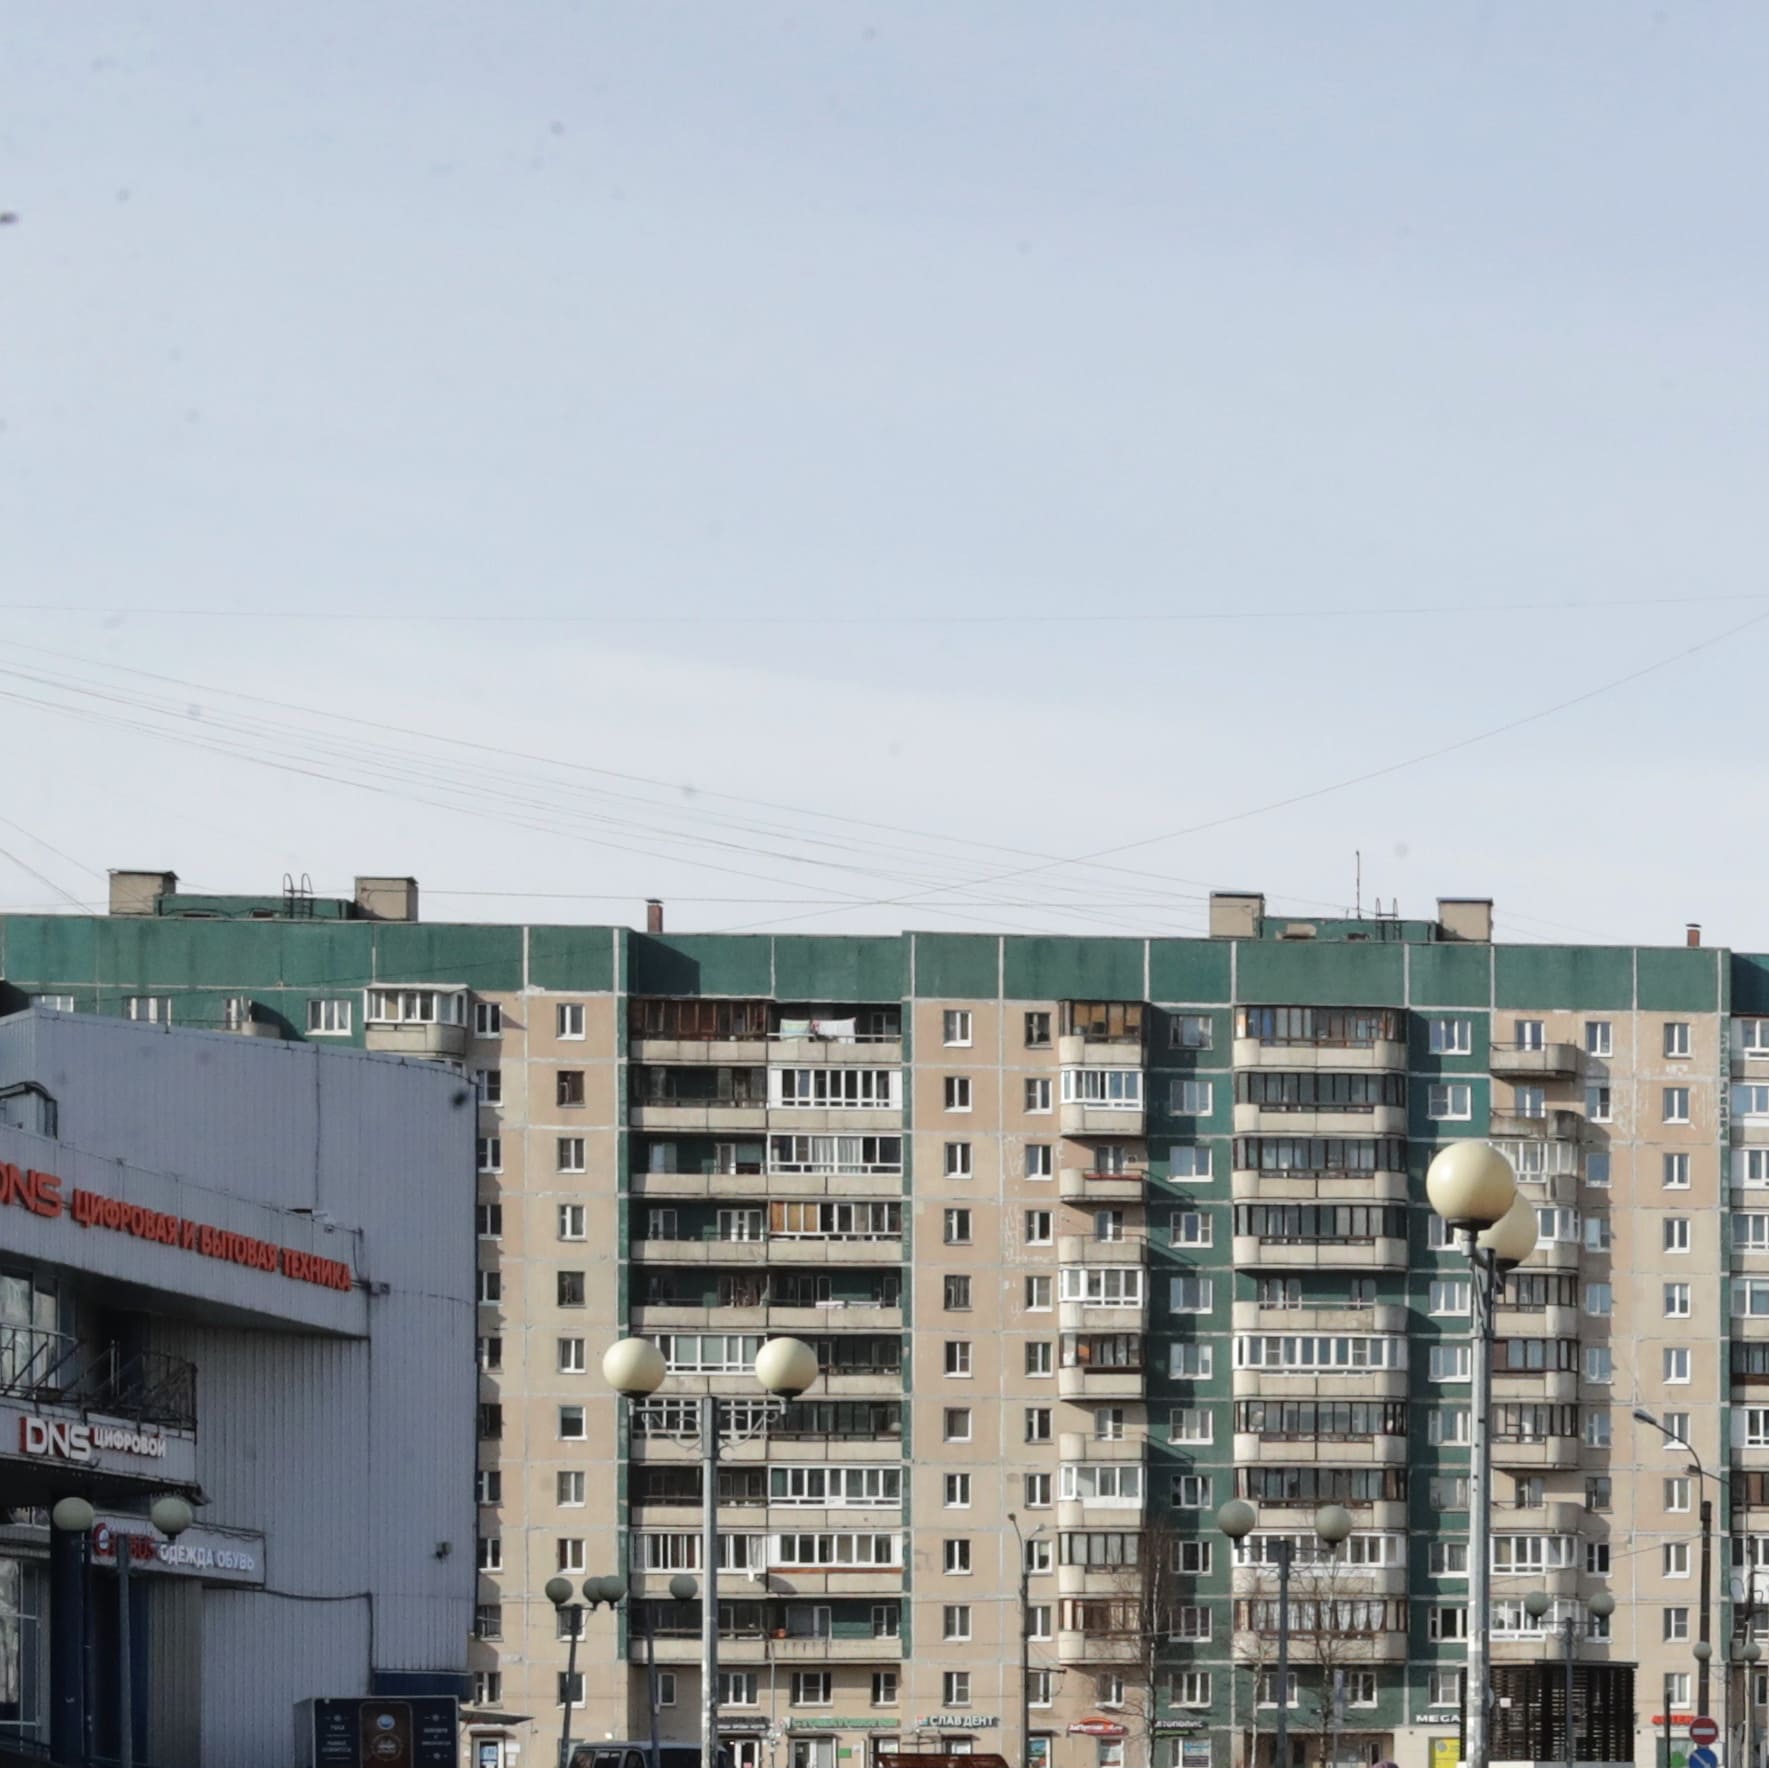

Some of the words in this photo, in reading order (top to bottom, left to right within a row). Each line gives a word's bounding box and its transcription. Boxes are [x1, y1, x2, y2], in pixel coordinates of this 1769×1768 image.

[73, 1189, 178, 1246] ЦИФРОВАЯ
[181, 1219, 195, 1250] И
[200, 1224, 278, 1272] БЫТОВАЯ
[282, 1249, 352, 1292] ТЕХНИКА
[21, 1416, 91, 1462] DNS
[160, 1544, 214, 1568] ОДЕЖДА
[217, 1550, 255, 1570] ОБУВЬ
[1415, 1714, 1460, 1723] MEGA
